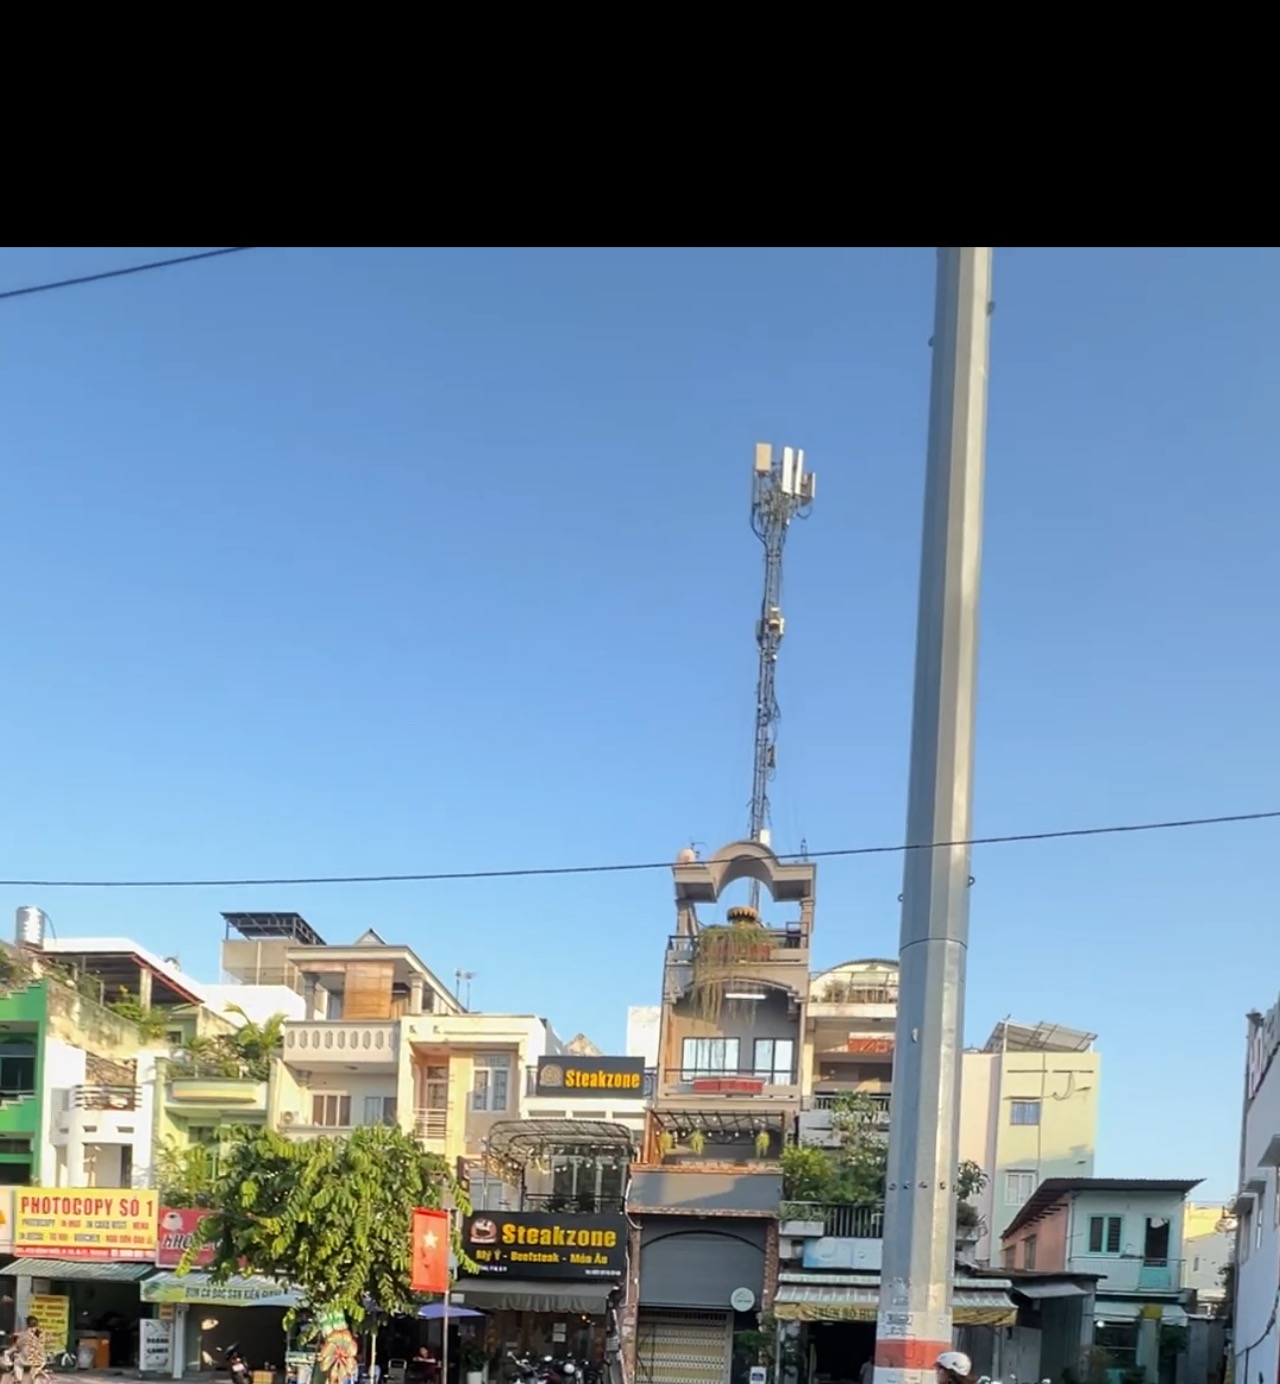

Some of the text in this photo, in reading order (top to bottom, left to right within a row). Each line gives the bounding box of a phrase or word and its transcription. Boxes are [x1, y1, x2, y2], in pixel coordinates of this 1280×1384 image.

[565, 1069, 640, 1088] Steakzone
[20, 1196, 113, 1216] PHOTOCOPY
[146, 1200, 153, 1217] 1
[502, 1223, 617, 1247] Steakzone
